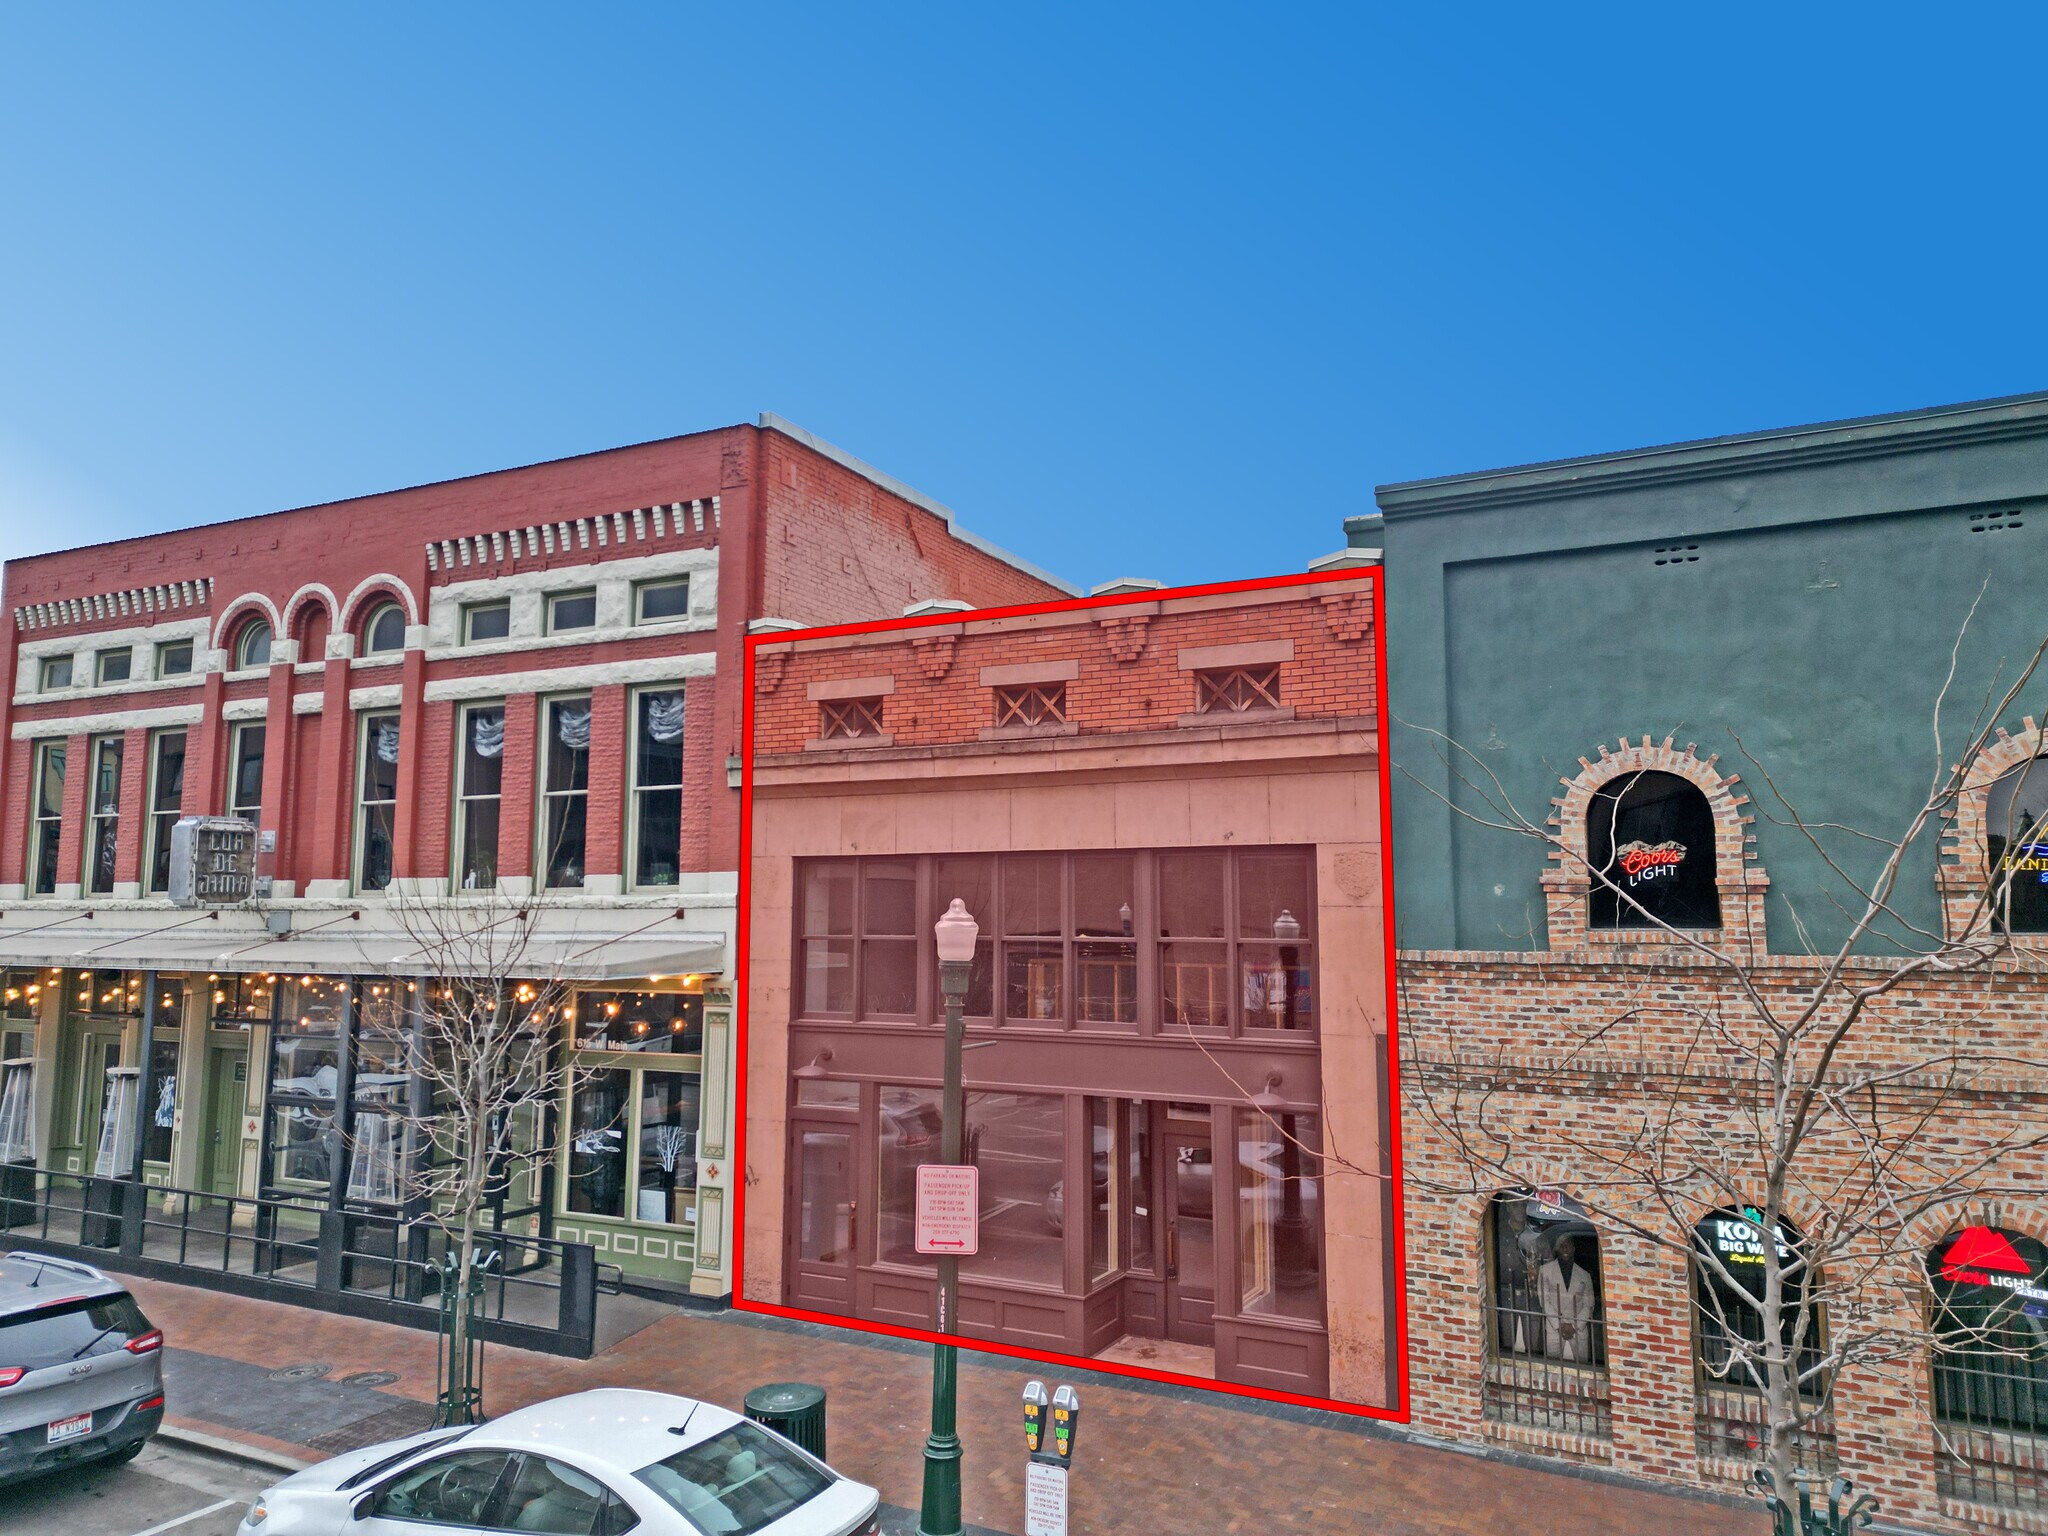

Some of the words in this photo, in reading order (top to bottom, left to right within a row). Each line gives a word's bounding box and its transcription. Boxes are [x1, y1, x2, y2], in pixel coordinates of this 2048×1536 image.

[210, 832, 244, 851] COA
[213, 853, 238, 873] DE
[1621, 849, 1680, 874] Coors
[1629, 864, 1677, 887] LIGHT
[595, 1039, 604, 1049] W
[607, 1040, 628, 1051] Main
[1719, 1239, 1745, 1253] BIG
[1746, 1242, 1790, 1258] WE
[1729, 1252, 1754, 1264] Liquid
[1990, 1274, 2034, 1289] LIGHT
[2022, 1287, 2044, 1299] ATM
